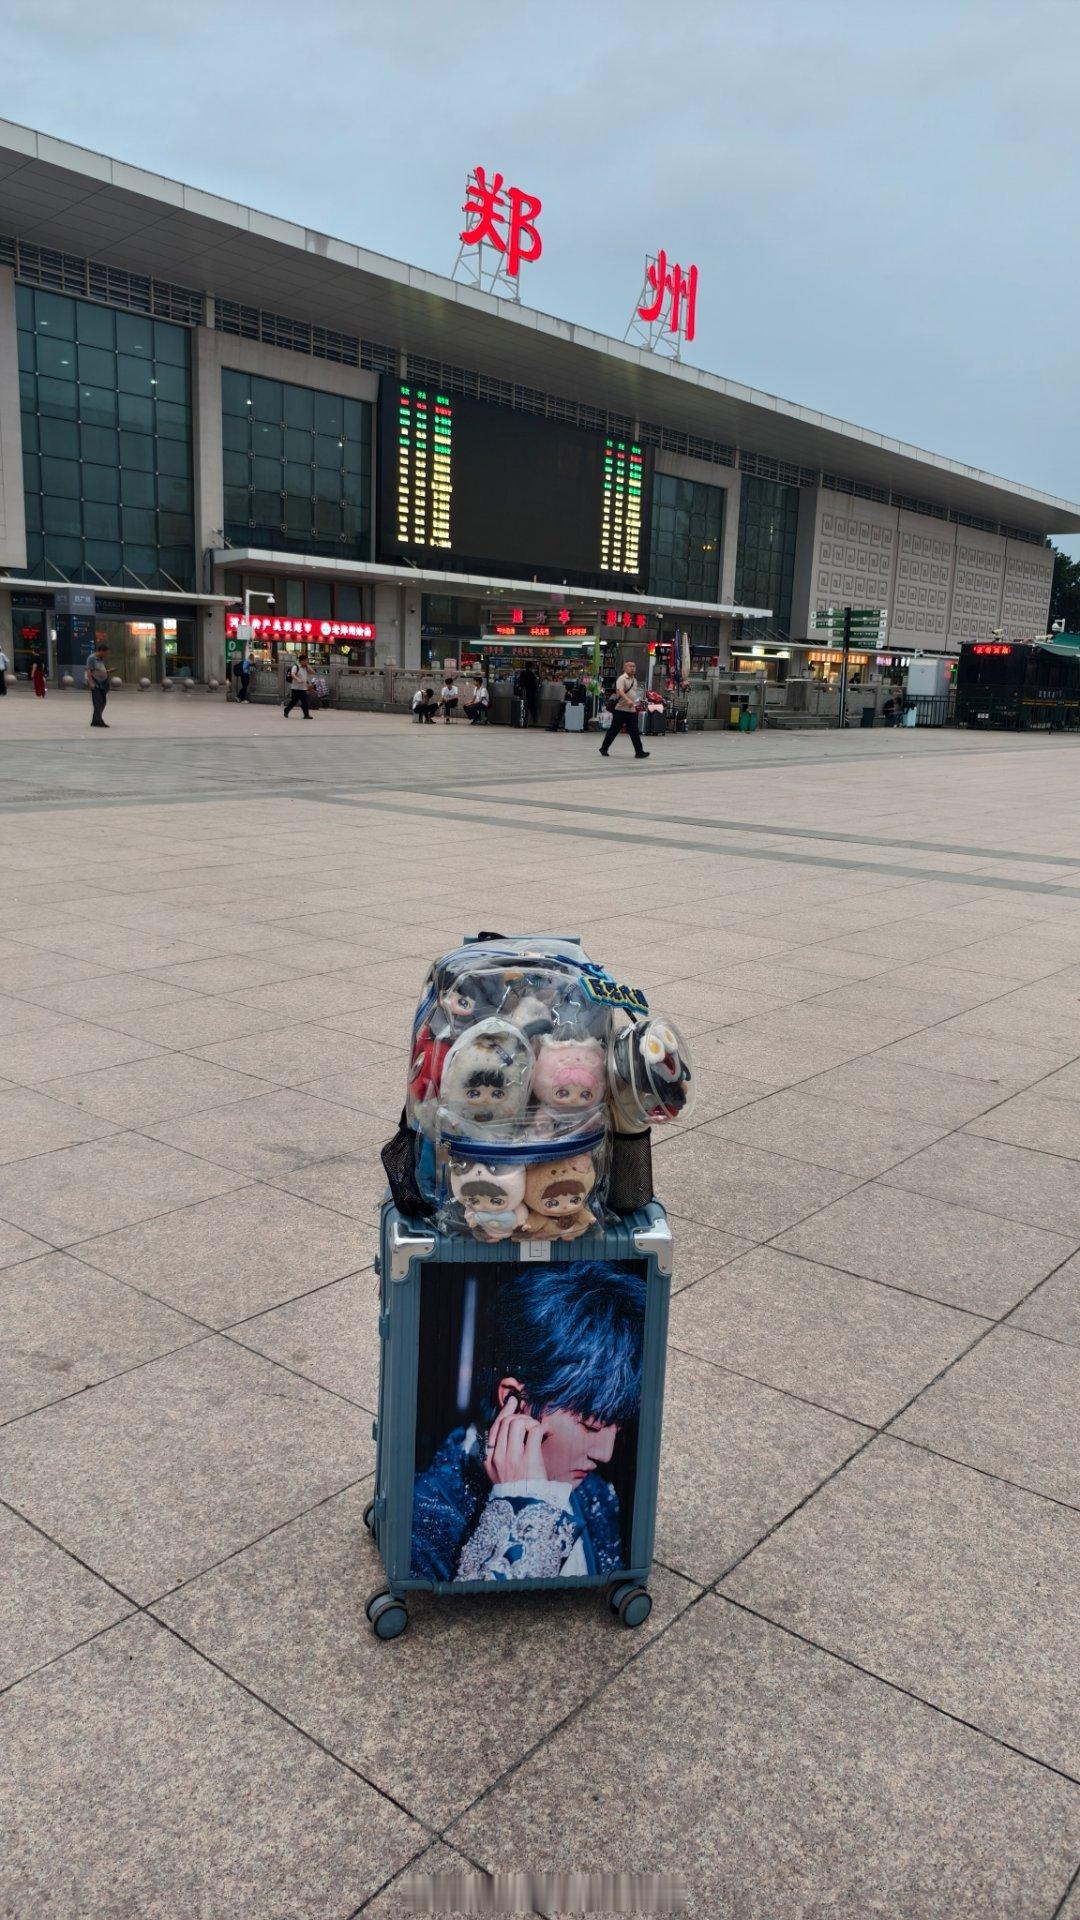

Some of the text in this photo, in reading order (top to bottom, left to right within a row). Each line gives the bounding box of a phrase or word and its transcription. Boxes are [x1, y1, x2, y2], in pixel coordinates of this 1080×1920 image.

[461, 166, 698, 341] 郑州
[512, 608, 571, 624] 服务亭
